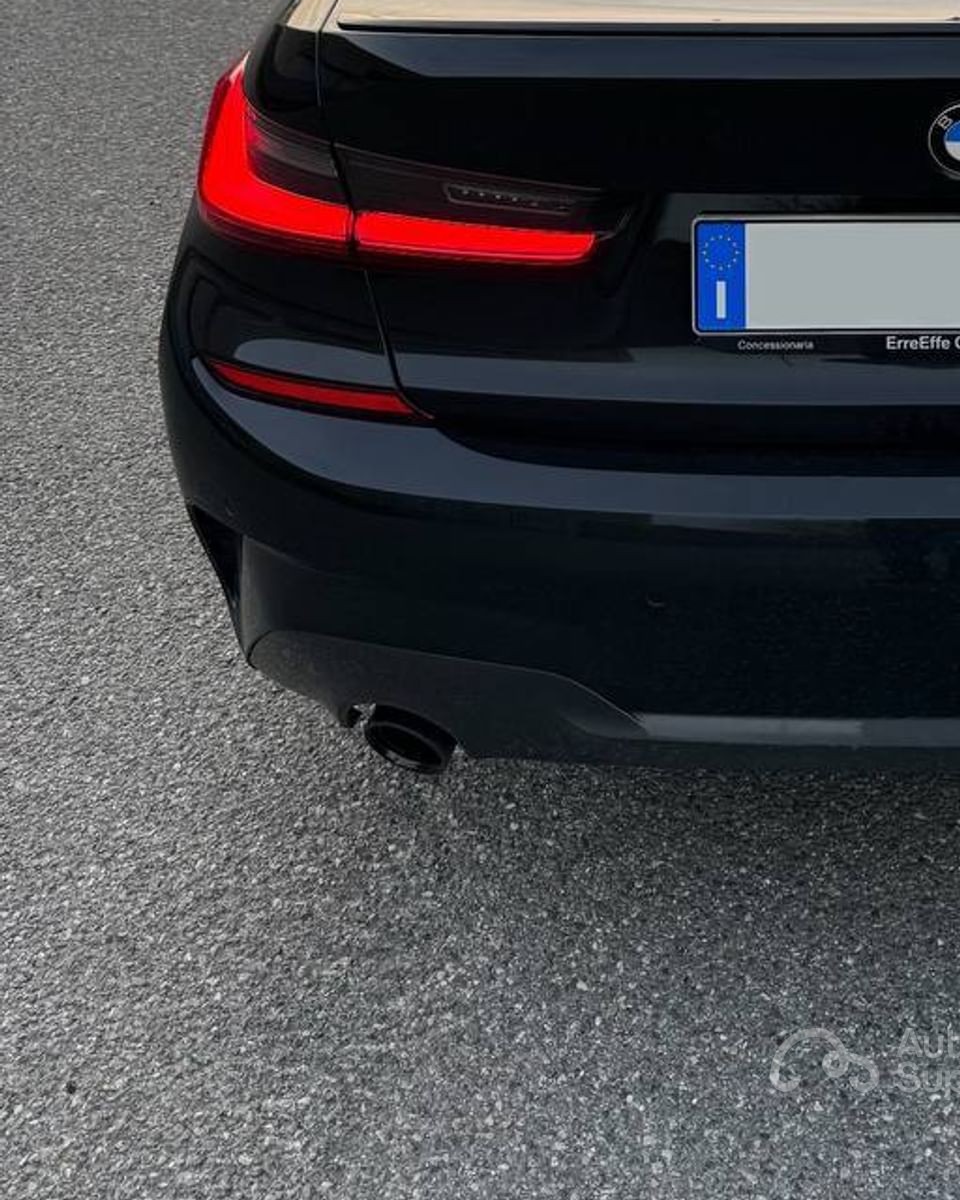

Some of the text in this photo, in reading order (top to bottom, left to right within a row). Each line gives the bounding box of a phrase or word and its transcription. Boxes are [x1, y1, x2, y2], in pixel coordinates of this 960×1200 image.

[716, 281, 727, 319] I
[737, 339, 814, 350] Concessionaria
[886, 335, 950, 350] ErreEffe
